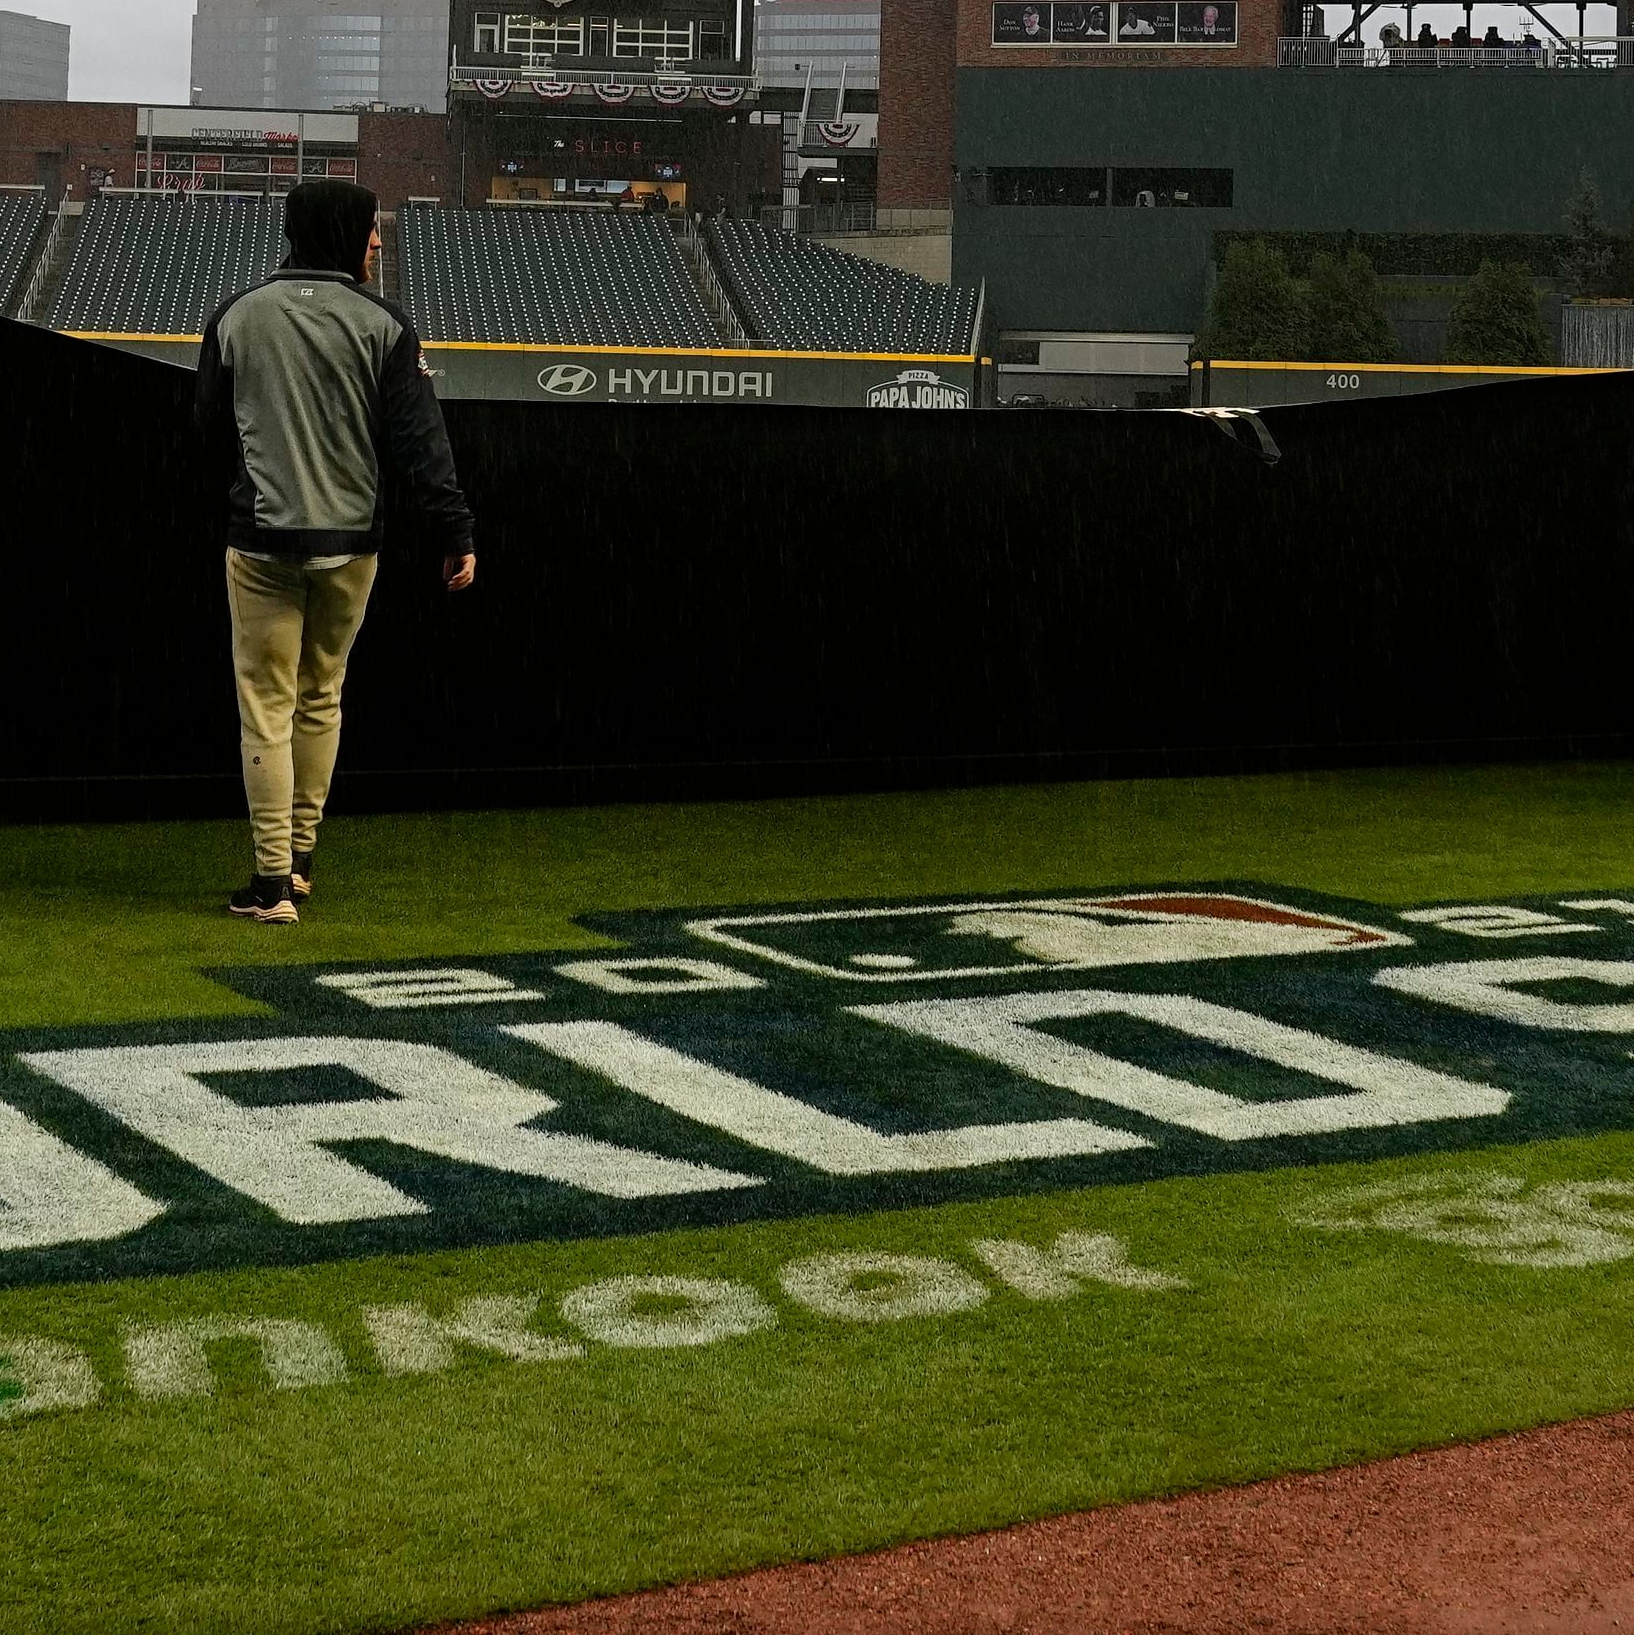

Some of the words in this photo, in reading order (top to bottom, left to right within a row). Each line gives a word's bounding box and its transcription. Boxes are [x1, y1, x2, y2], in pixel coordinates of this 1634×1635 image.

[575, 139, 642, 154] SLICE
[608, 368, 773, 398] HYUNDAI
[908, 371, 930, 380] PIZZA
[1326, 373, 1361, 389] 400
[870, 388, 908, 408] PAPA
[911, 386, 968, 409] JOHN'S
[313, 954, 770, 1009] 20
